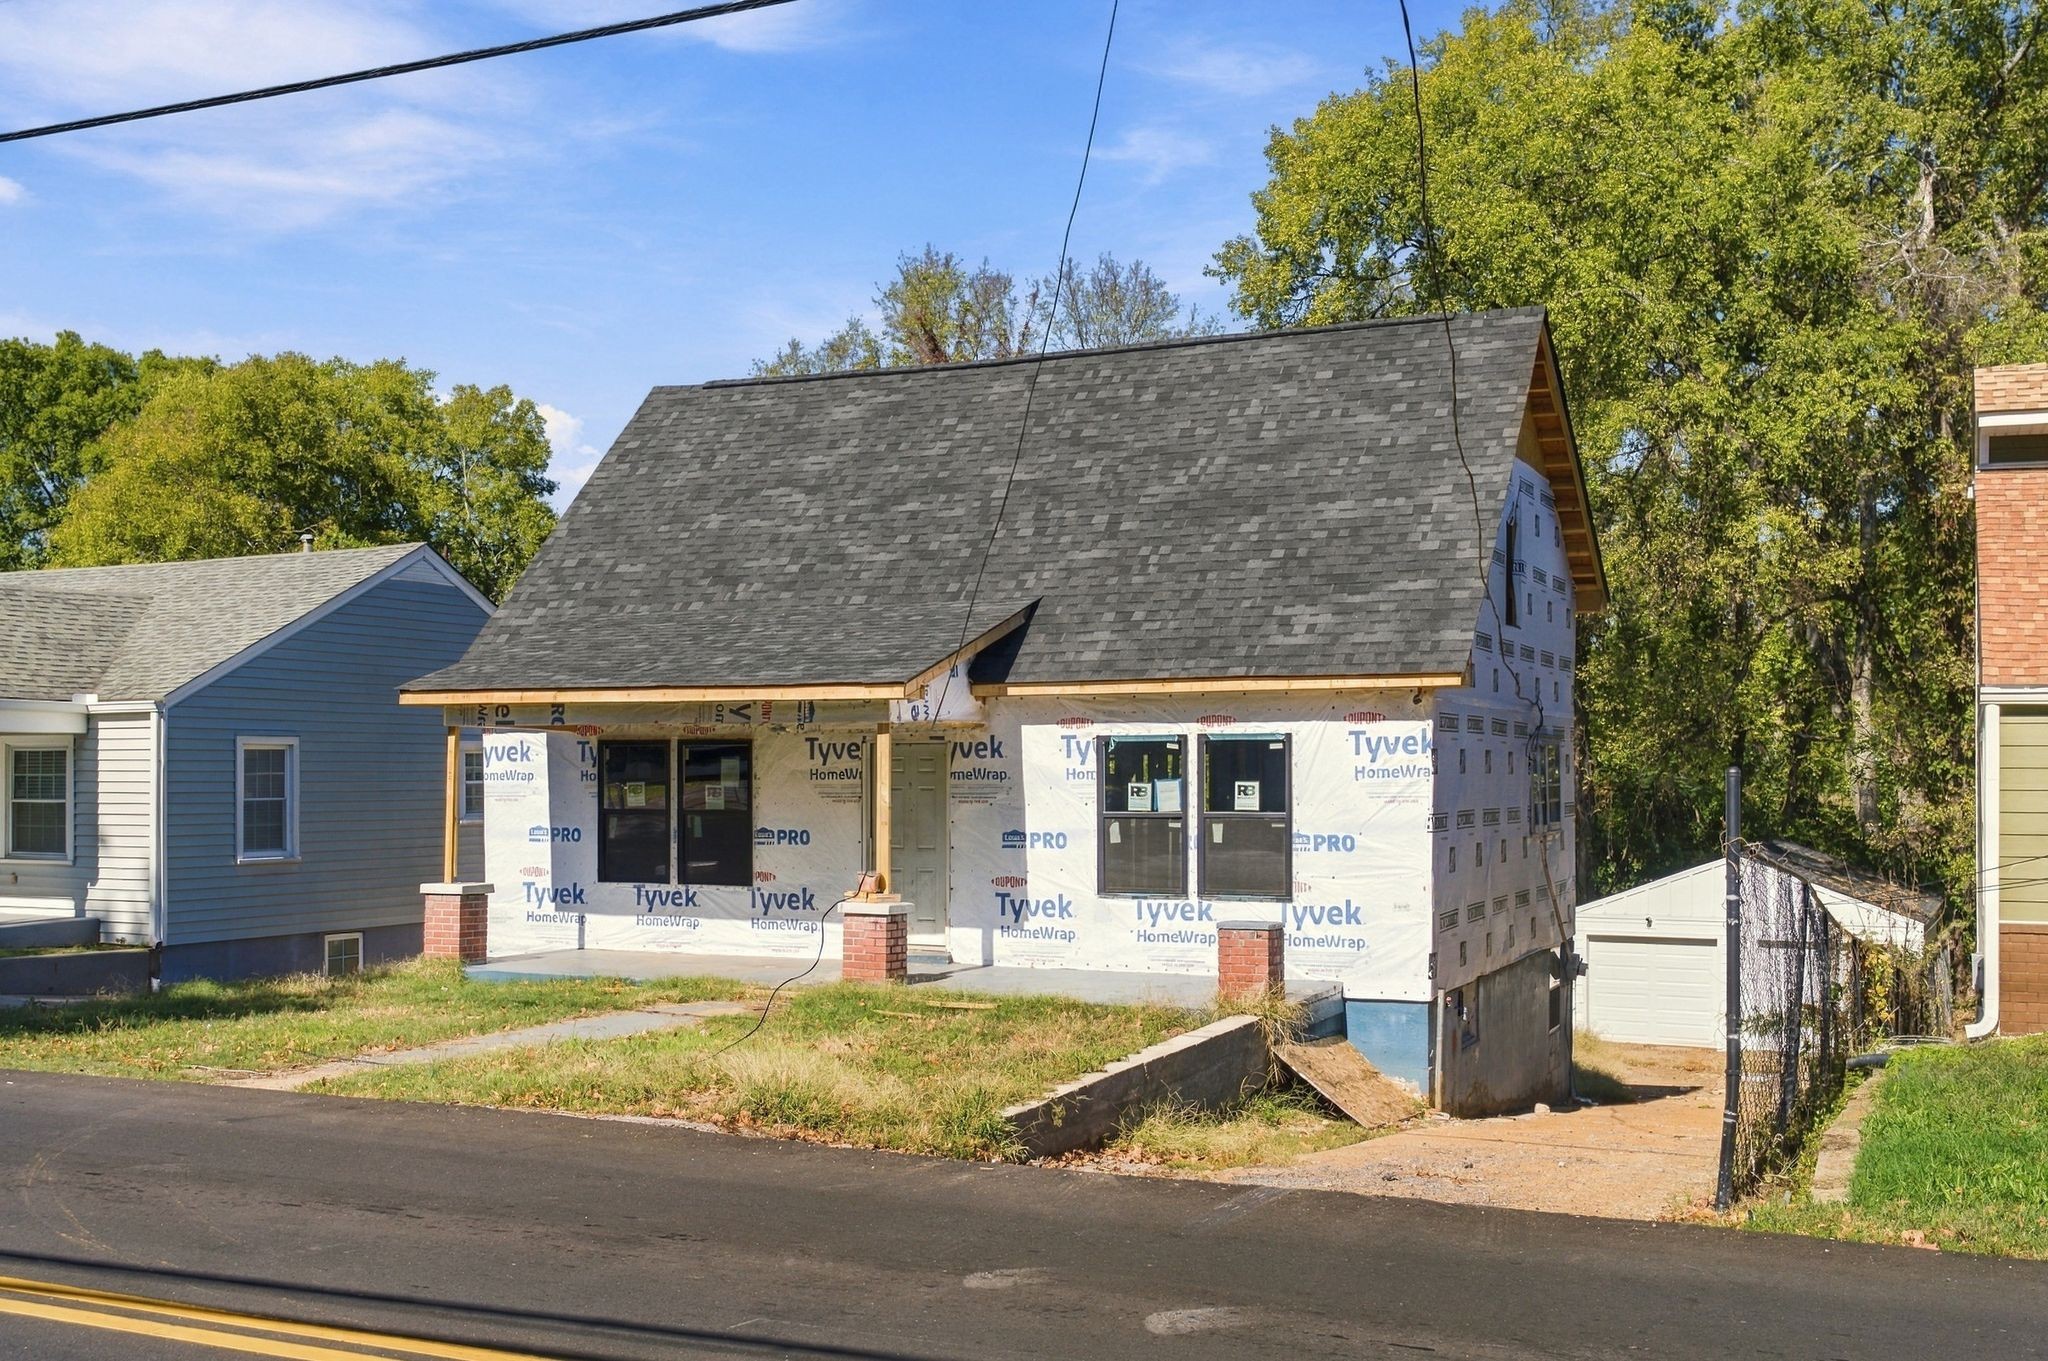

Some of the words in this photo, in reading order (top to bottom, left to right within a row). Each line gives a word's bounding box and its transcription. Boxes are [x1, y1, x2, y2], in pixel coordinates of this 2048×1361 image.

[1059, 717, 1092, 730] DUPONT
[1199, 714, 1234, 728] DUPONT
[1346, 711, 1383, 725] DUPONT
[483, 740, 532, 768] yvek
[577, 740, 597, 768] Ty
[805, 737, 862, 766] Tyve
[1061, 735, 1096, 765] Ty
[484, 769, 535, 785] omeWrap
[580, 770, 597, 782] Ho
[1354, 765, 1431, 780] HomeWra
[550, 827, 582, 843] PRO
[777, 829, 811, 846] PRO
[1029, 832, 1068, 850] PRO
[1313, 834, 1356, 853] PRO
[755, 871, 774, 882] PONT
[994, 876, 1026, 888] DUPONT
[522, 882, 586, 909] Tyvek
[633, 884, 698, 913] Tyvek
[995, 892, 1073, 924] Tyvek
[526, 911, 588, 927] HomeWrap
[636, 914, 700, 930] HomeWrap
[751, 917, 819, 934] HomeWrap
[1000, 925, 1076, 943] HomeWrap
[1137, 929, 1217, 947] HomeWrap
[1284, 934, 1366, 951] HomeWrap
